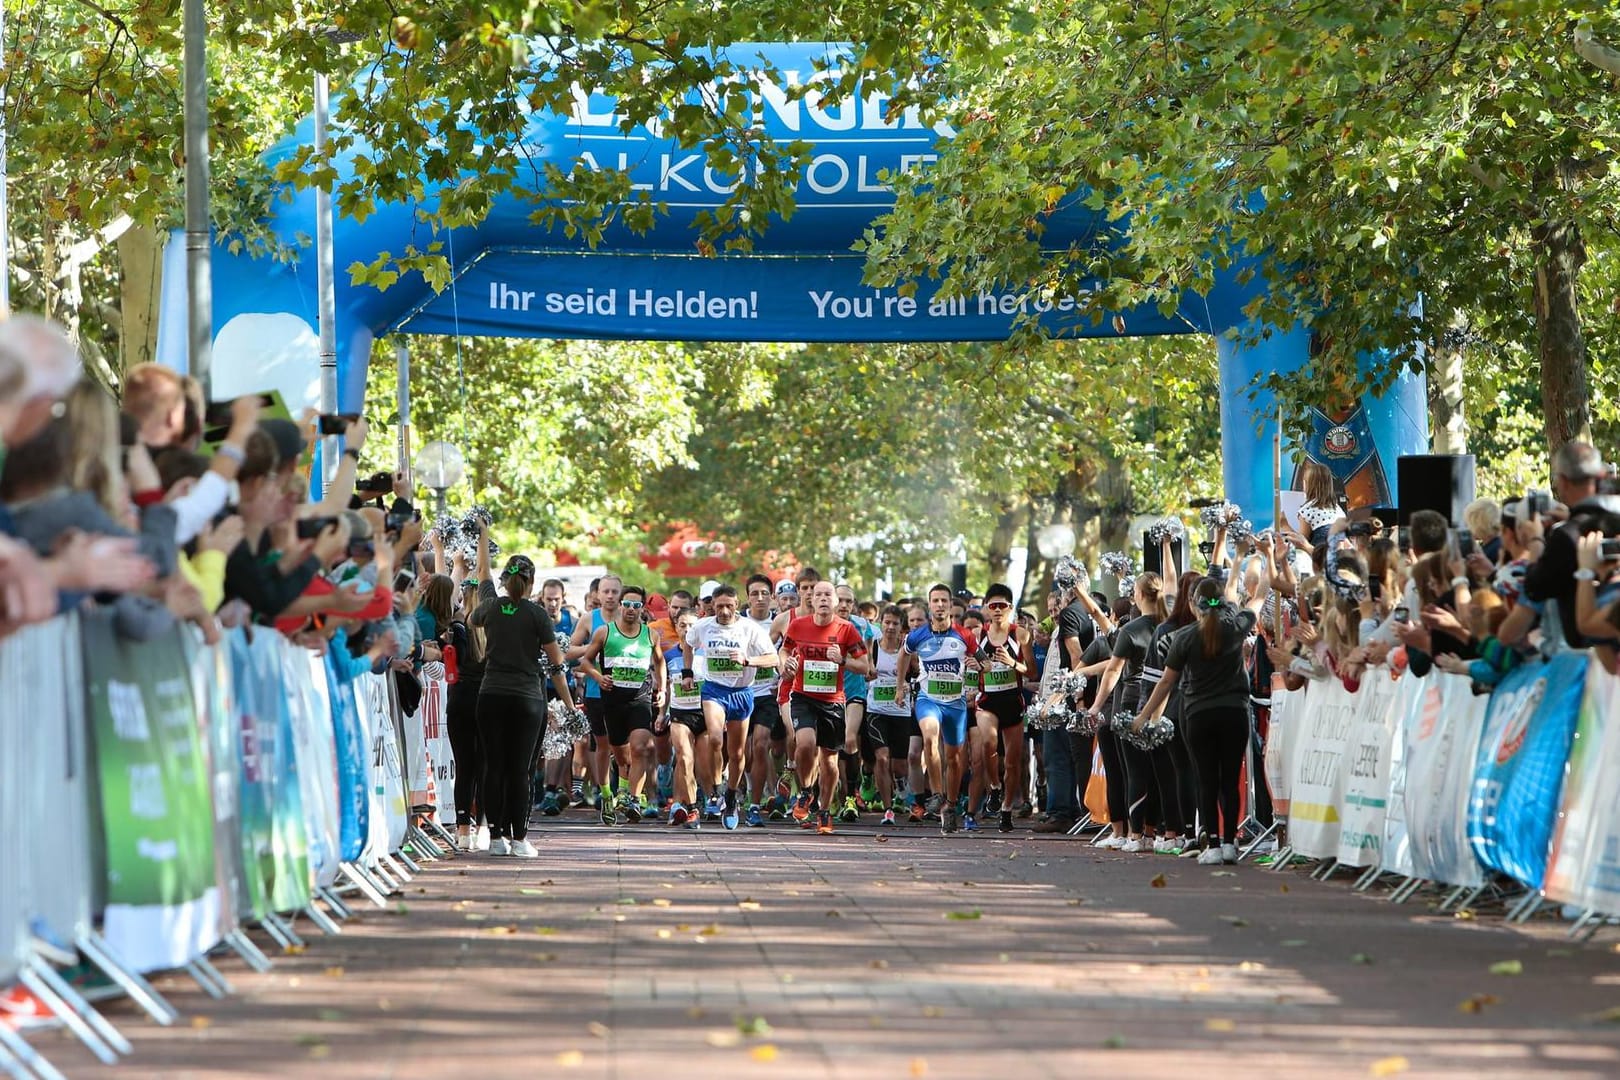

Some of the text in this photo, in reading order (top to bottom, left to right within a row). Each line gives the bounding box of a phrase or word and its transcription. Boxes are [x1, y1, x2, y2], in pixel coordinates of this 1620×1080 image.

[489, 282, 758, 319] Ihr seid Helden!
[808, 288, 917, 319] You're
[928, 291, 966, 317] all
[708, 640, 741, 649] ITALIA
[800, 644, 828, 659] KEN
[926, 662, 959, 672] WERK
[808, 670, 833, 681] 2435
[990, 671, 1009, 680] 1010
[877, 686, 897, 696] 243
[936, 680, 953, 691] 1511
